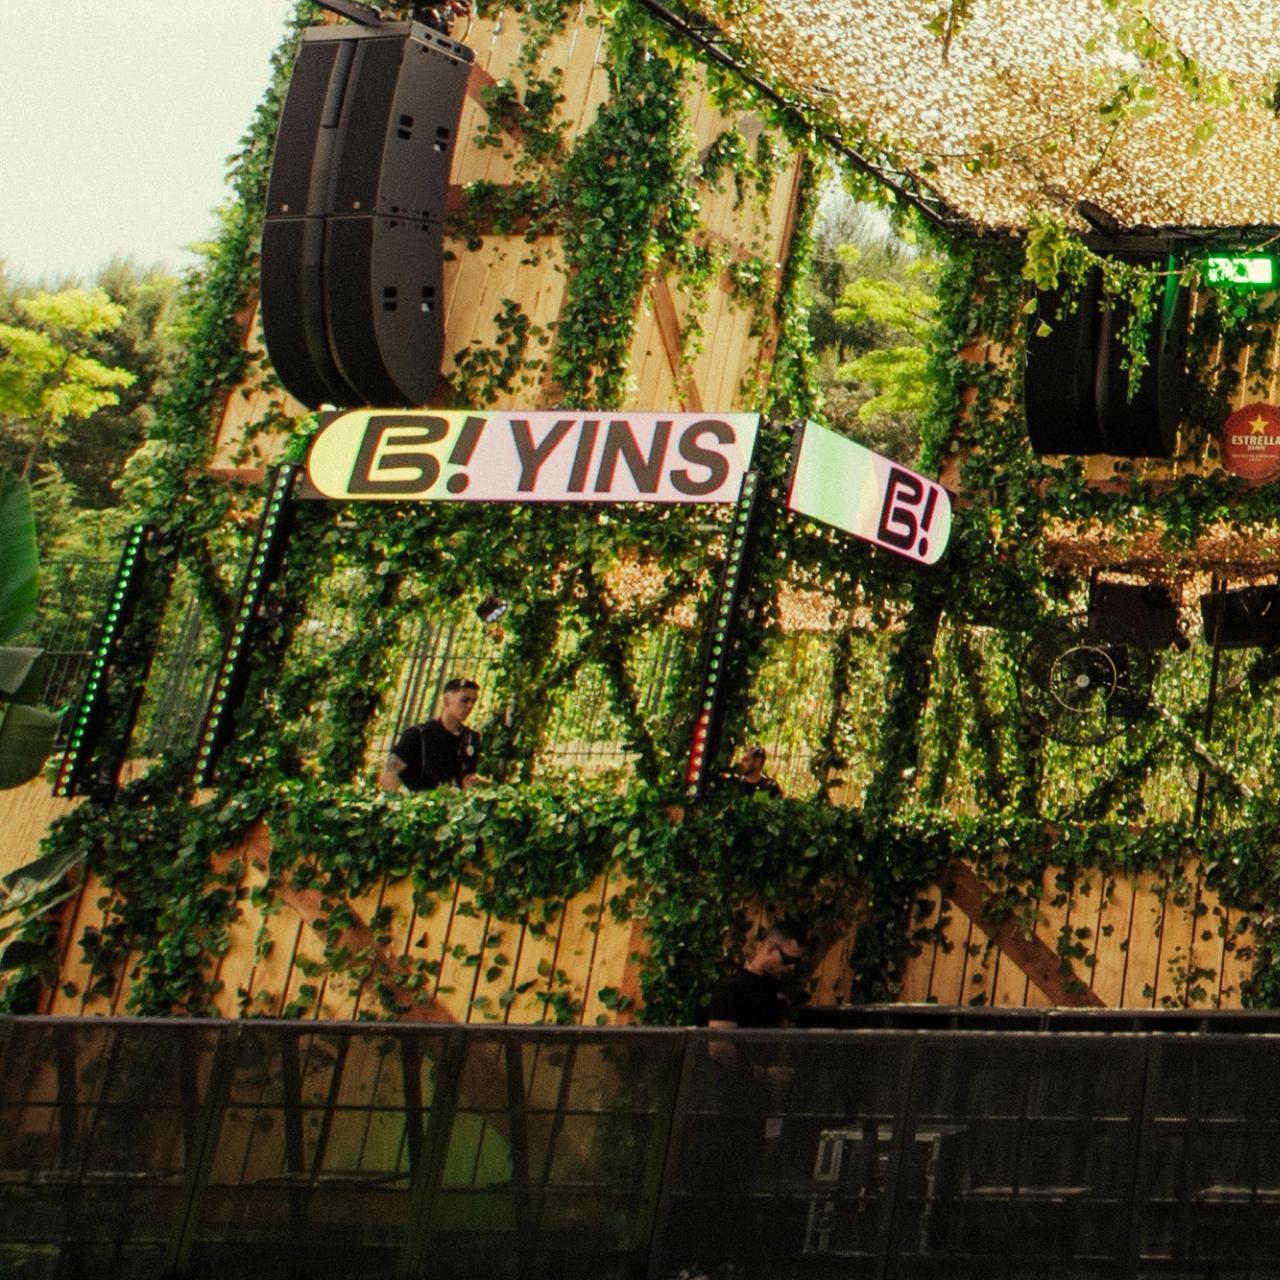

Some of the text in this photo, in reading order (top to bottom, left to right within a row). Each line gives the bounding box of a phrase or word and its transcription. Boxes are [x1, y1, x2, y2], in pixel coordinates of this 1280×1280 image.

[347, 415, 736, 495] B! YINS
[876, 466, 938, 555] B!
